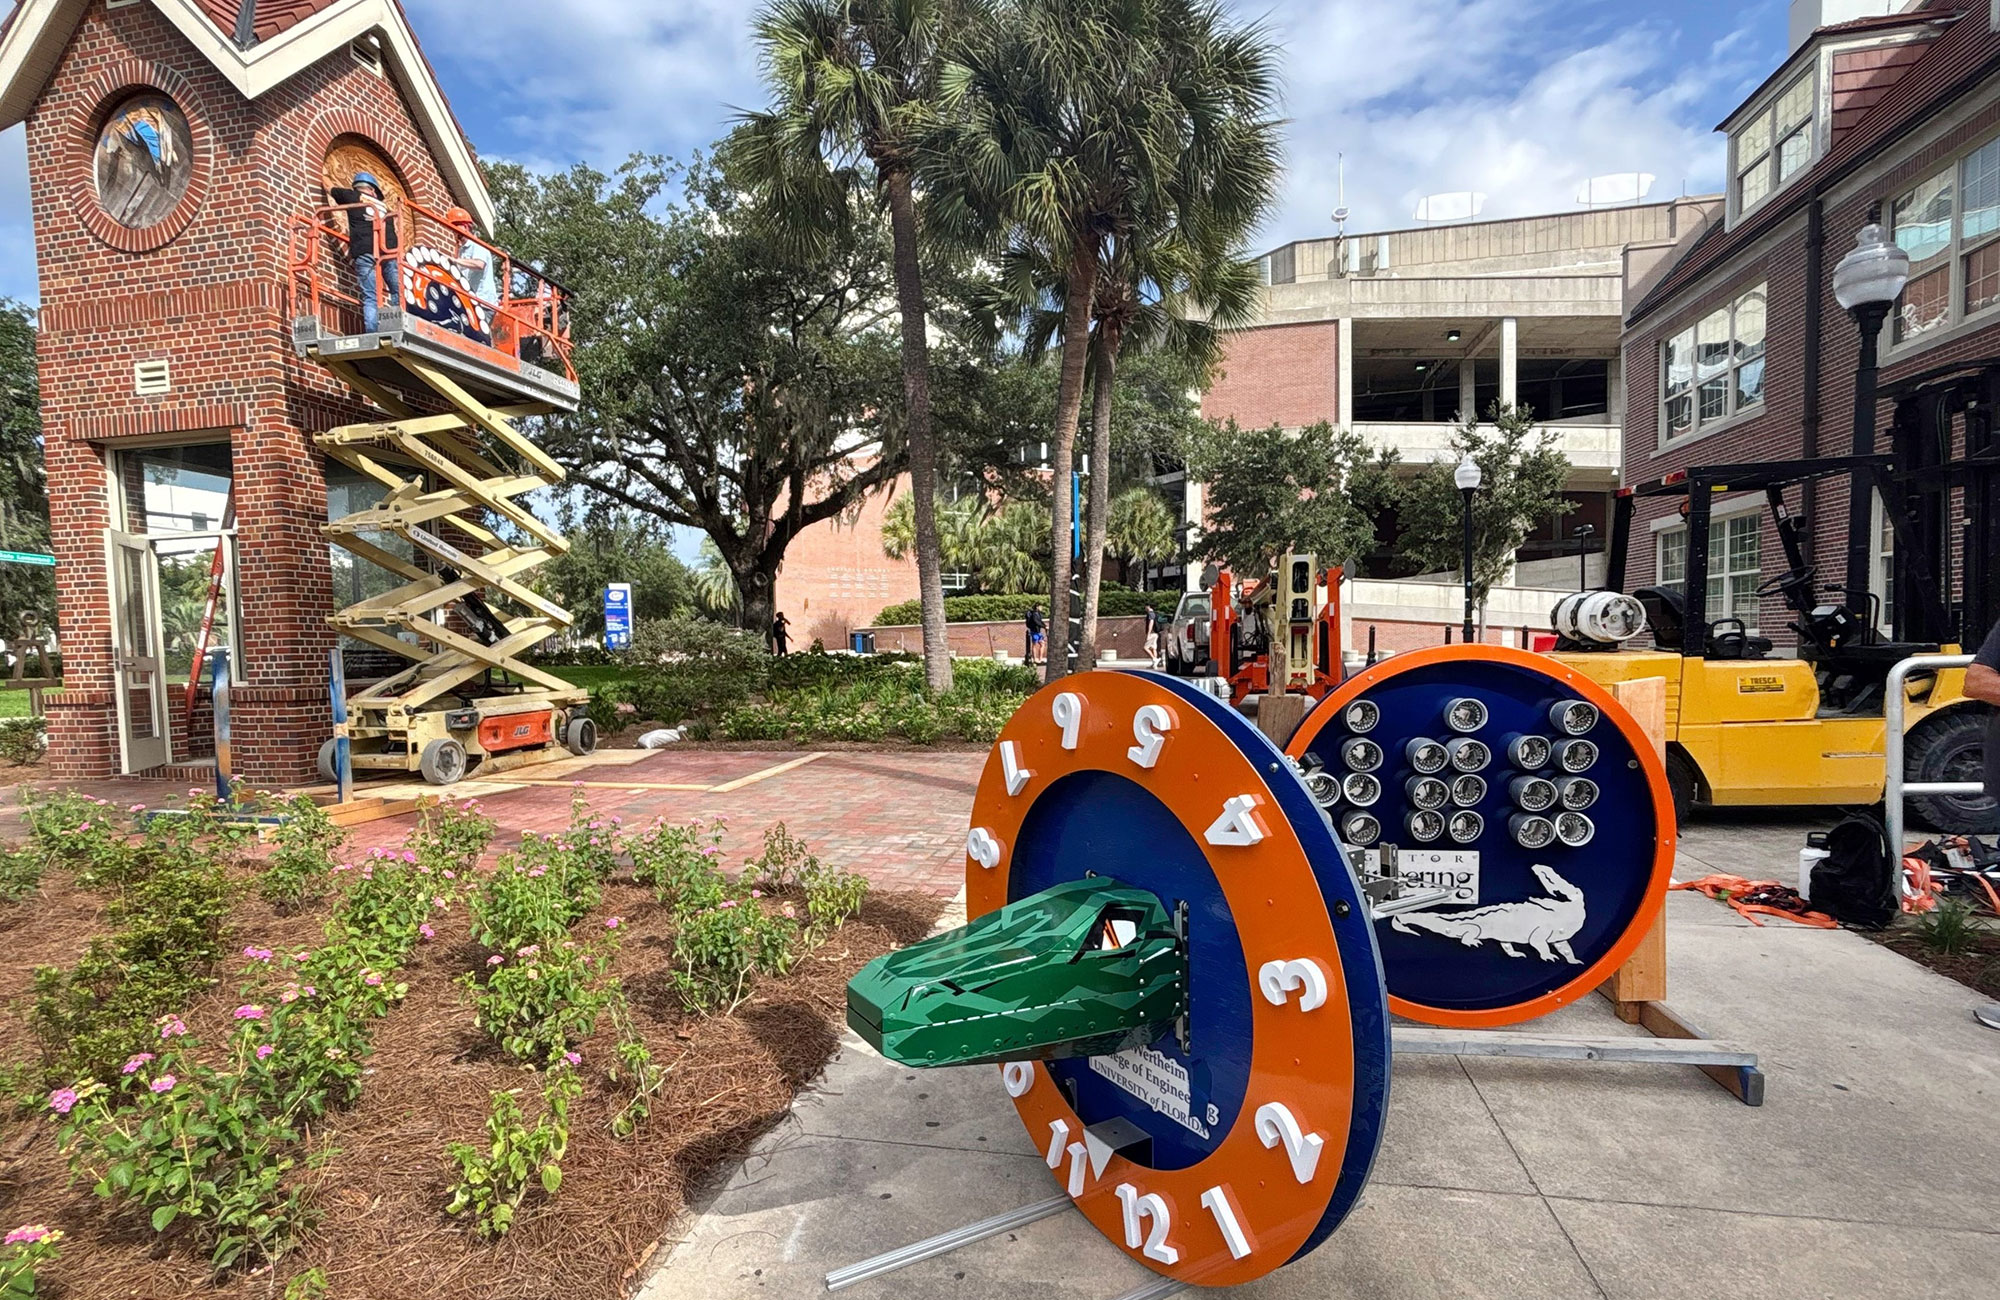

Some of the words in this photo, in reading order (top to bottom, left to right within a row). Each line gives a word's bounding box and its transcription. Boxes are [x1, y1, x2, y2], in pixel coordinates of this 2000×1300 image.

[513, 725, 529, 737] JLG
[1203, 794, 1264, 846] 4
[968, 827, 1000, 868] 8
[1259, 958, 1327, 1012] 3
[1132, 1063, 1143, 1076] of
[1094, 1059, 1149, 1101] UNIVERSITY
[1150, 1098, 1159, 1110] of
[1161, 1100, 1207, 1137] FLORIDA
[1255, 1101, 1324, 1184] 2
[1115, 1183, 1179, 1265] 12
[1200, 1185, 1252, 1260] 1
